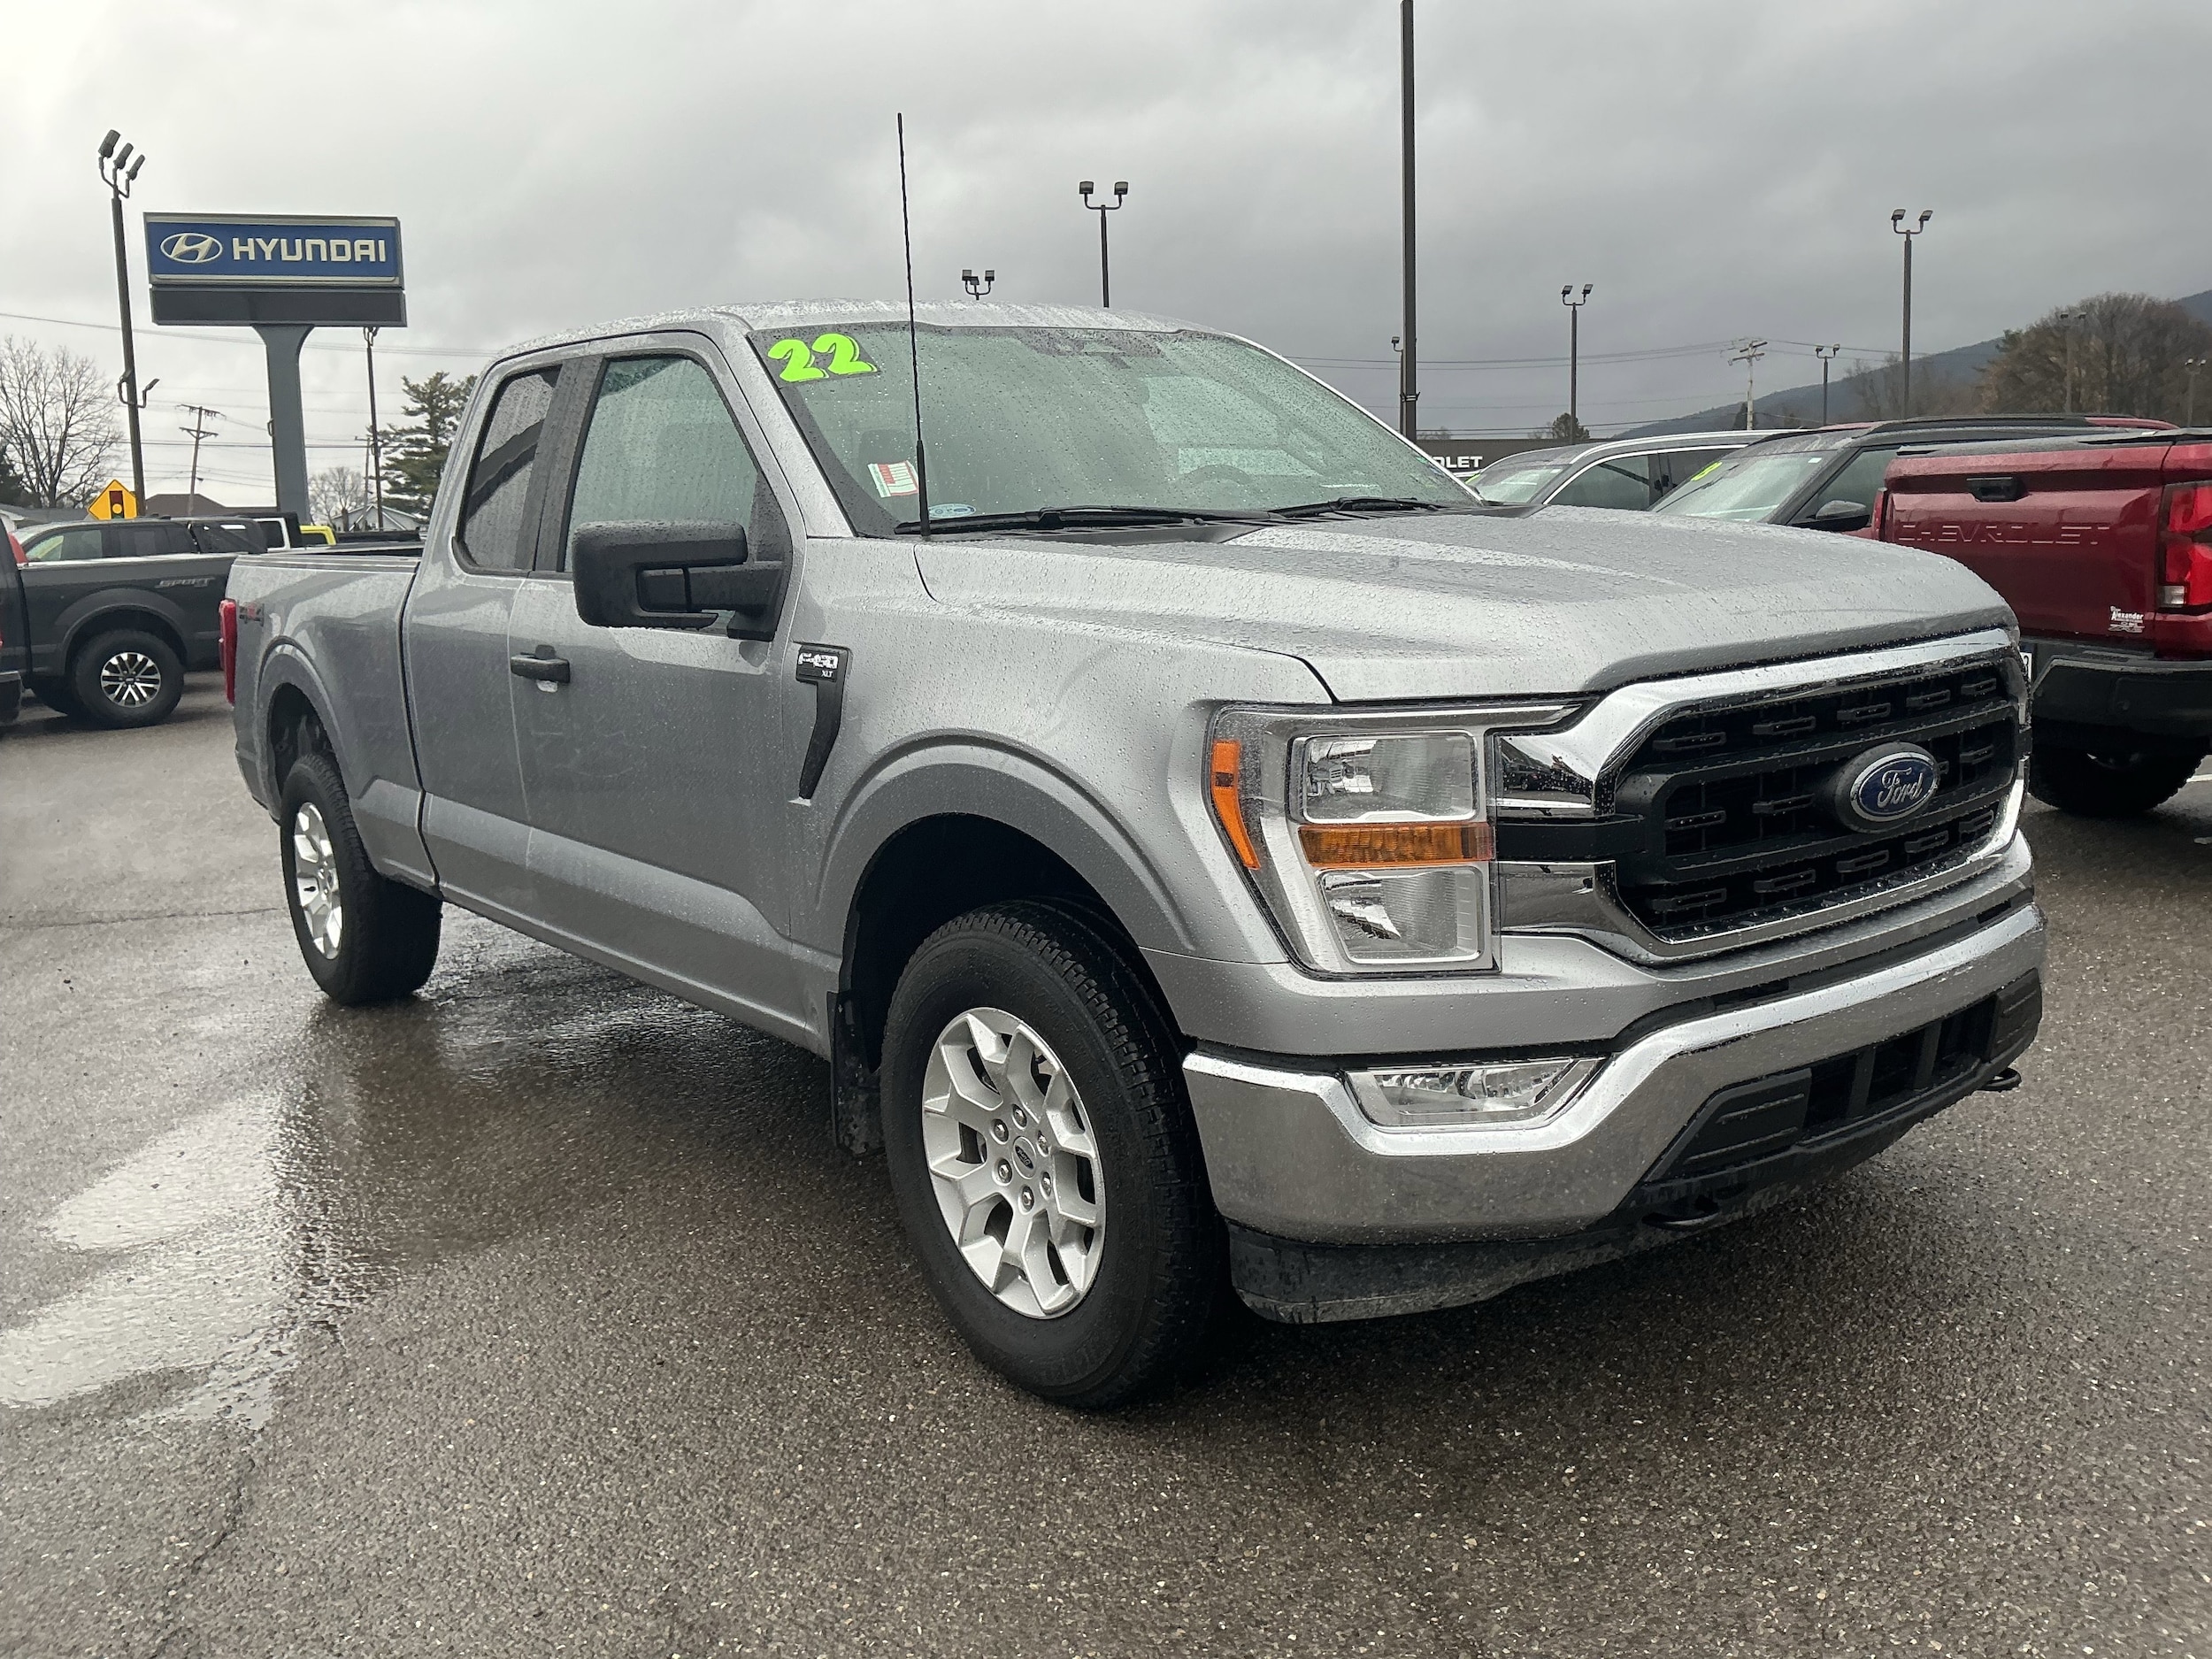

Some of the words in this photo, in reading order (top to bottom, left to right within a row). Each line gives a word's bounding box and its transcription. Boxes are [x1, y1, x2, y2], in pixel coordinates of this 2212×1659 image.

[233, 238, 386, 262] HYUNDAI
[767, 334, 878, 382] 22
[1898, 525, 2111, 545] CHEVROLET
[2111, 611, 2144, 620] Alexander
[1877, 767, 1924, 808] Ford
